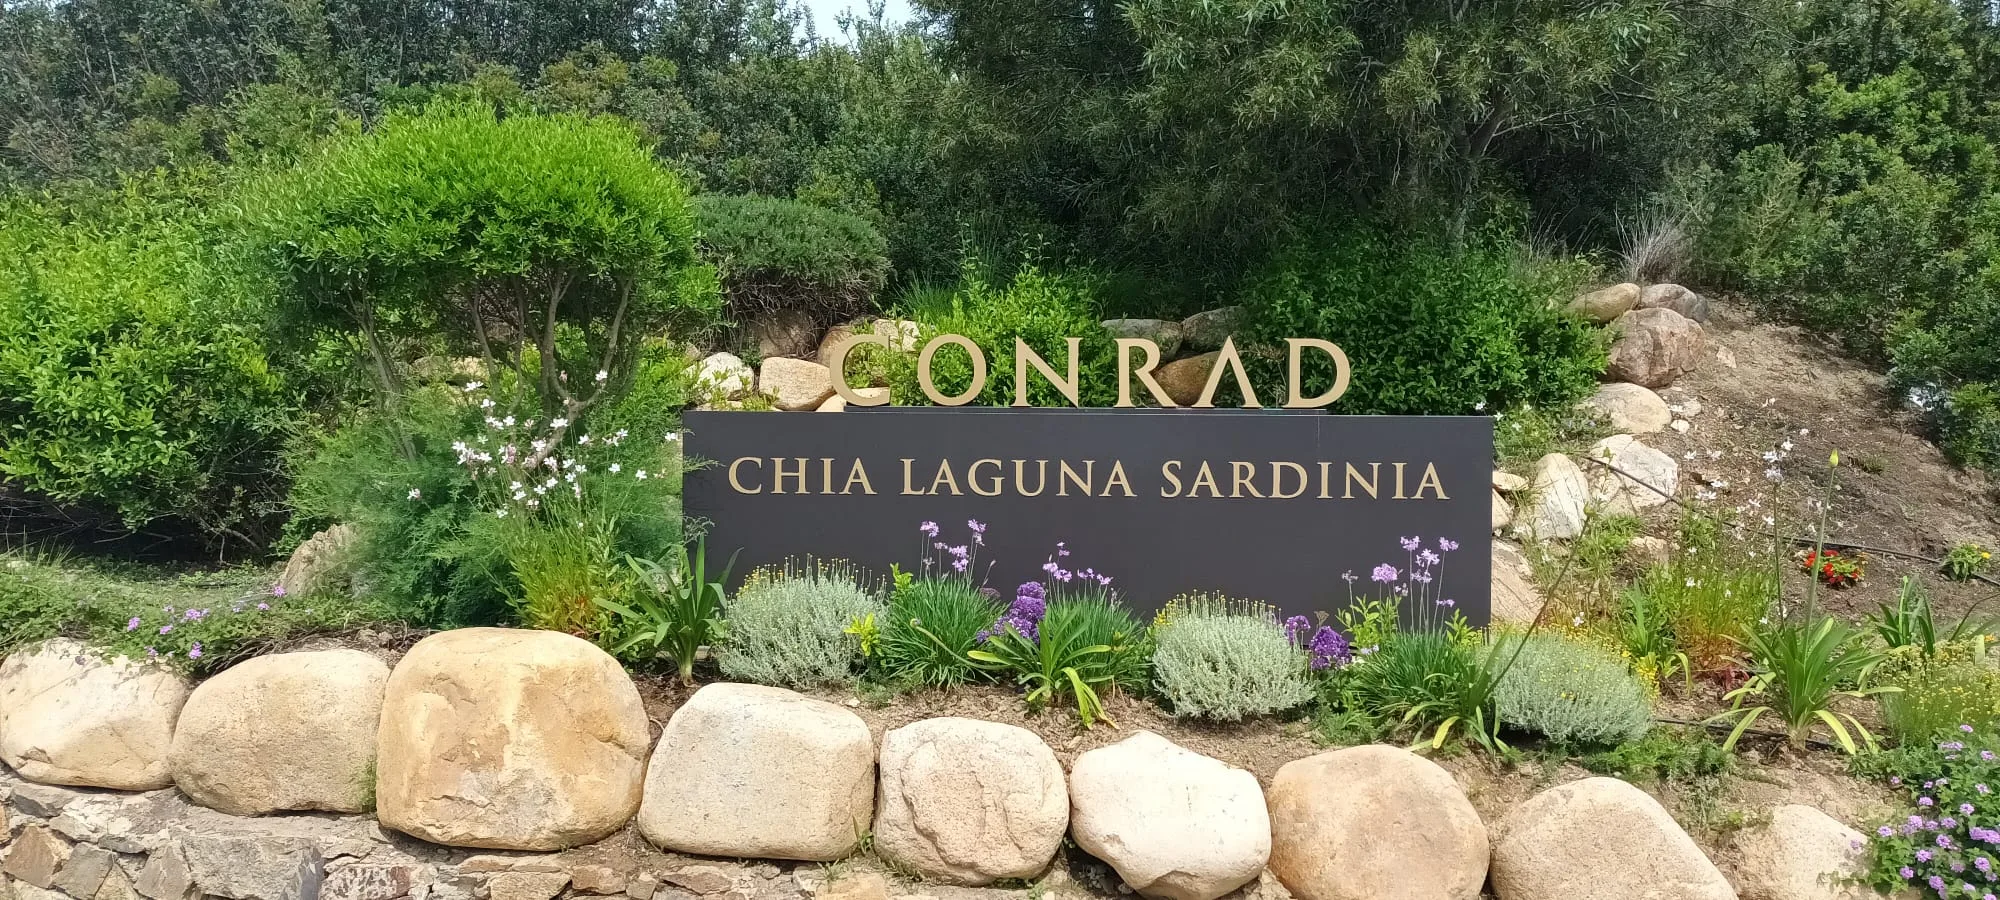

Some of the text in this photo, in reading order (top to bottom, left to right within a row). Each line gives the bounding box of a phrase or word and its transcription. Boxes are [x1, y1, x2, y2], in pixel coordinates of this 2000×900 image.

[829, 333, 1351, 409] CONRAD
[727, 456, 1450, 501] CHIA LAGUNA SARDINIA
